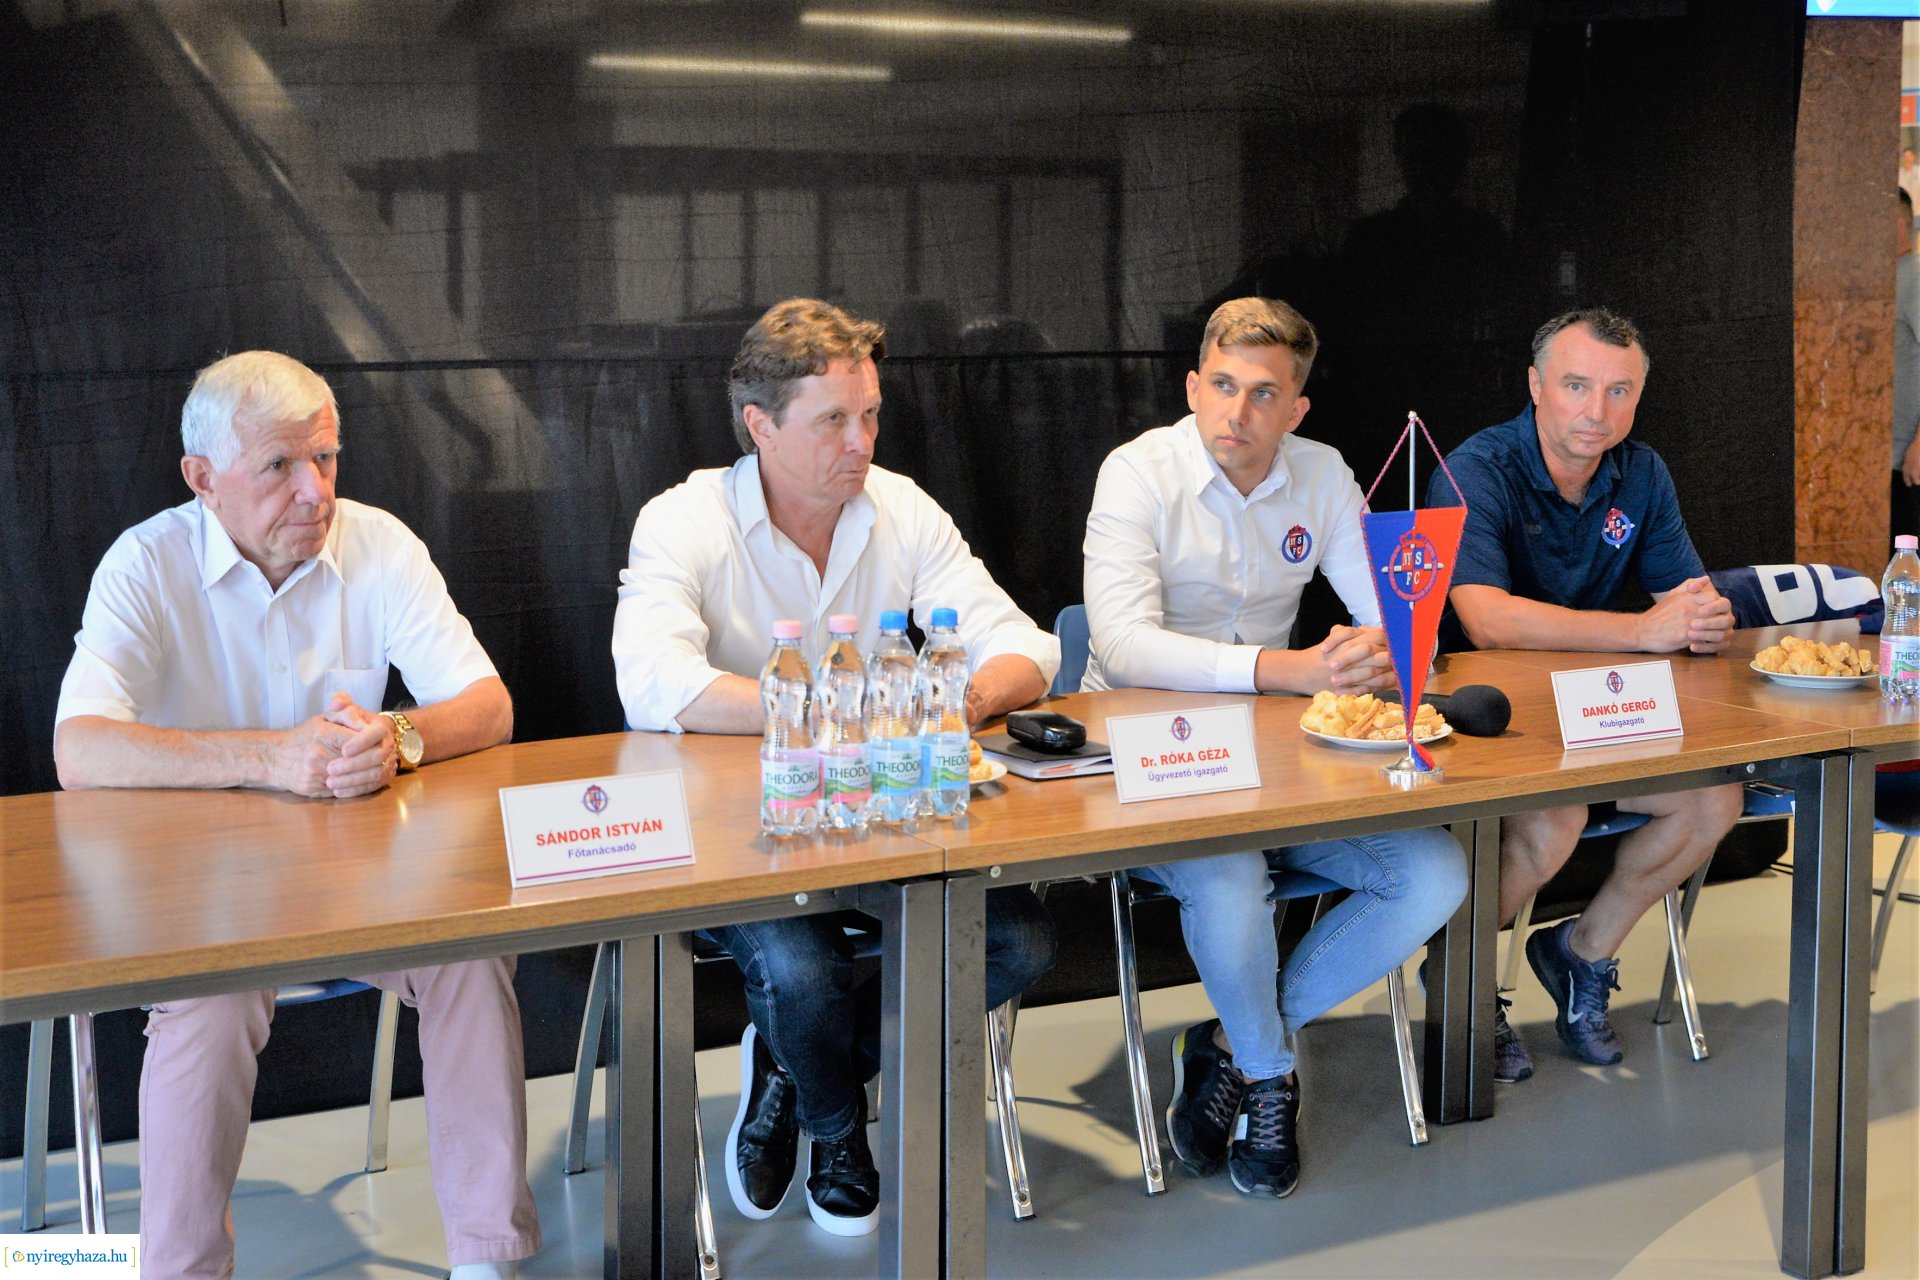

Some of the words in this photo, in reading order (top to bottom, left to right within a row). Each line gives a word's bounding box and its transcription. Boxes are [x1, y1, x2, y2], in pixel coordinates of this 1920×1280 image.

[1582, 702, 1618, 717] DANKÓ
[1621, 697, 1656, 713] GERGŐ
[1600, 716, 1645, 728] Klubigazgató
[1141, 757, 1157, 767] Dr.
[1160, 751, 1195, 765] RÓKA
[1198, 747, 1230, 761] GÉZA
[1148, 770, 1192, 782] Ügyvezető
[1193, 765, 1228, 777] igazgató
[536, 827, 601, 846] SÁNDOR
[606, 818, 662, 837] ISTVÁN
[568, 842, 637, 859] Főtanácsadó
